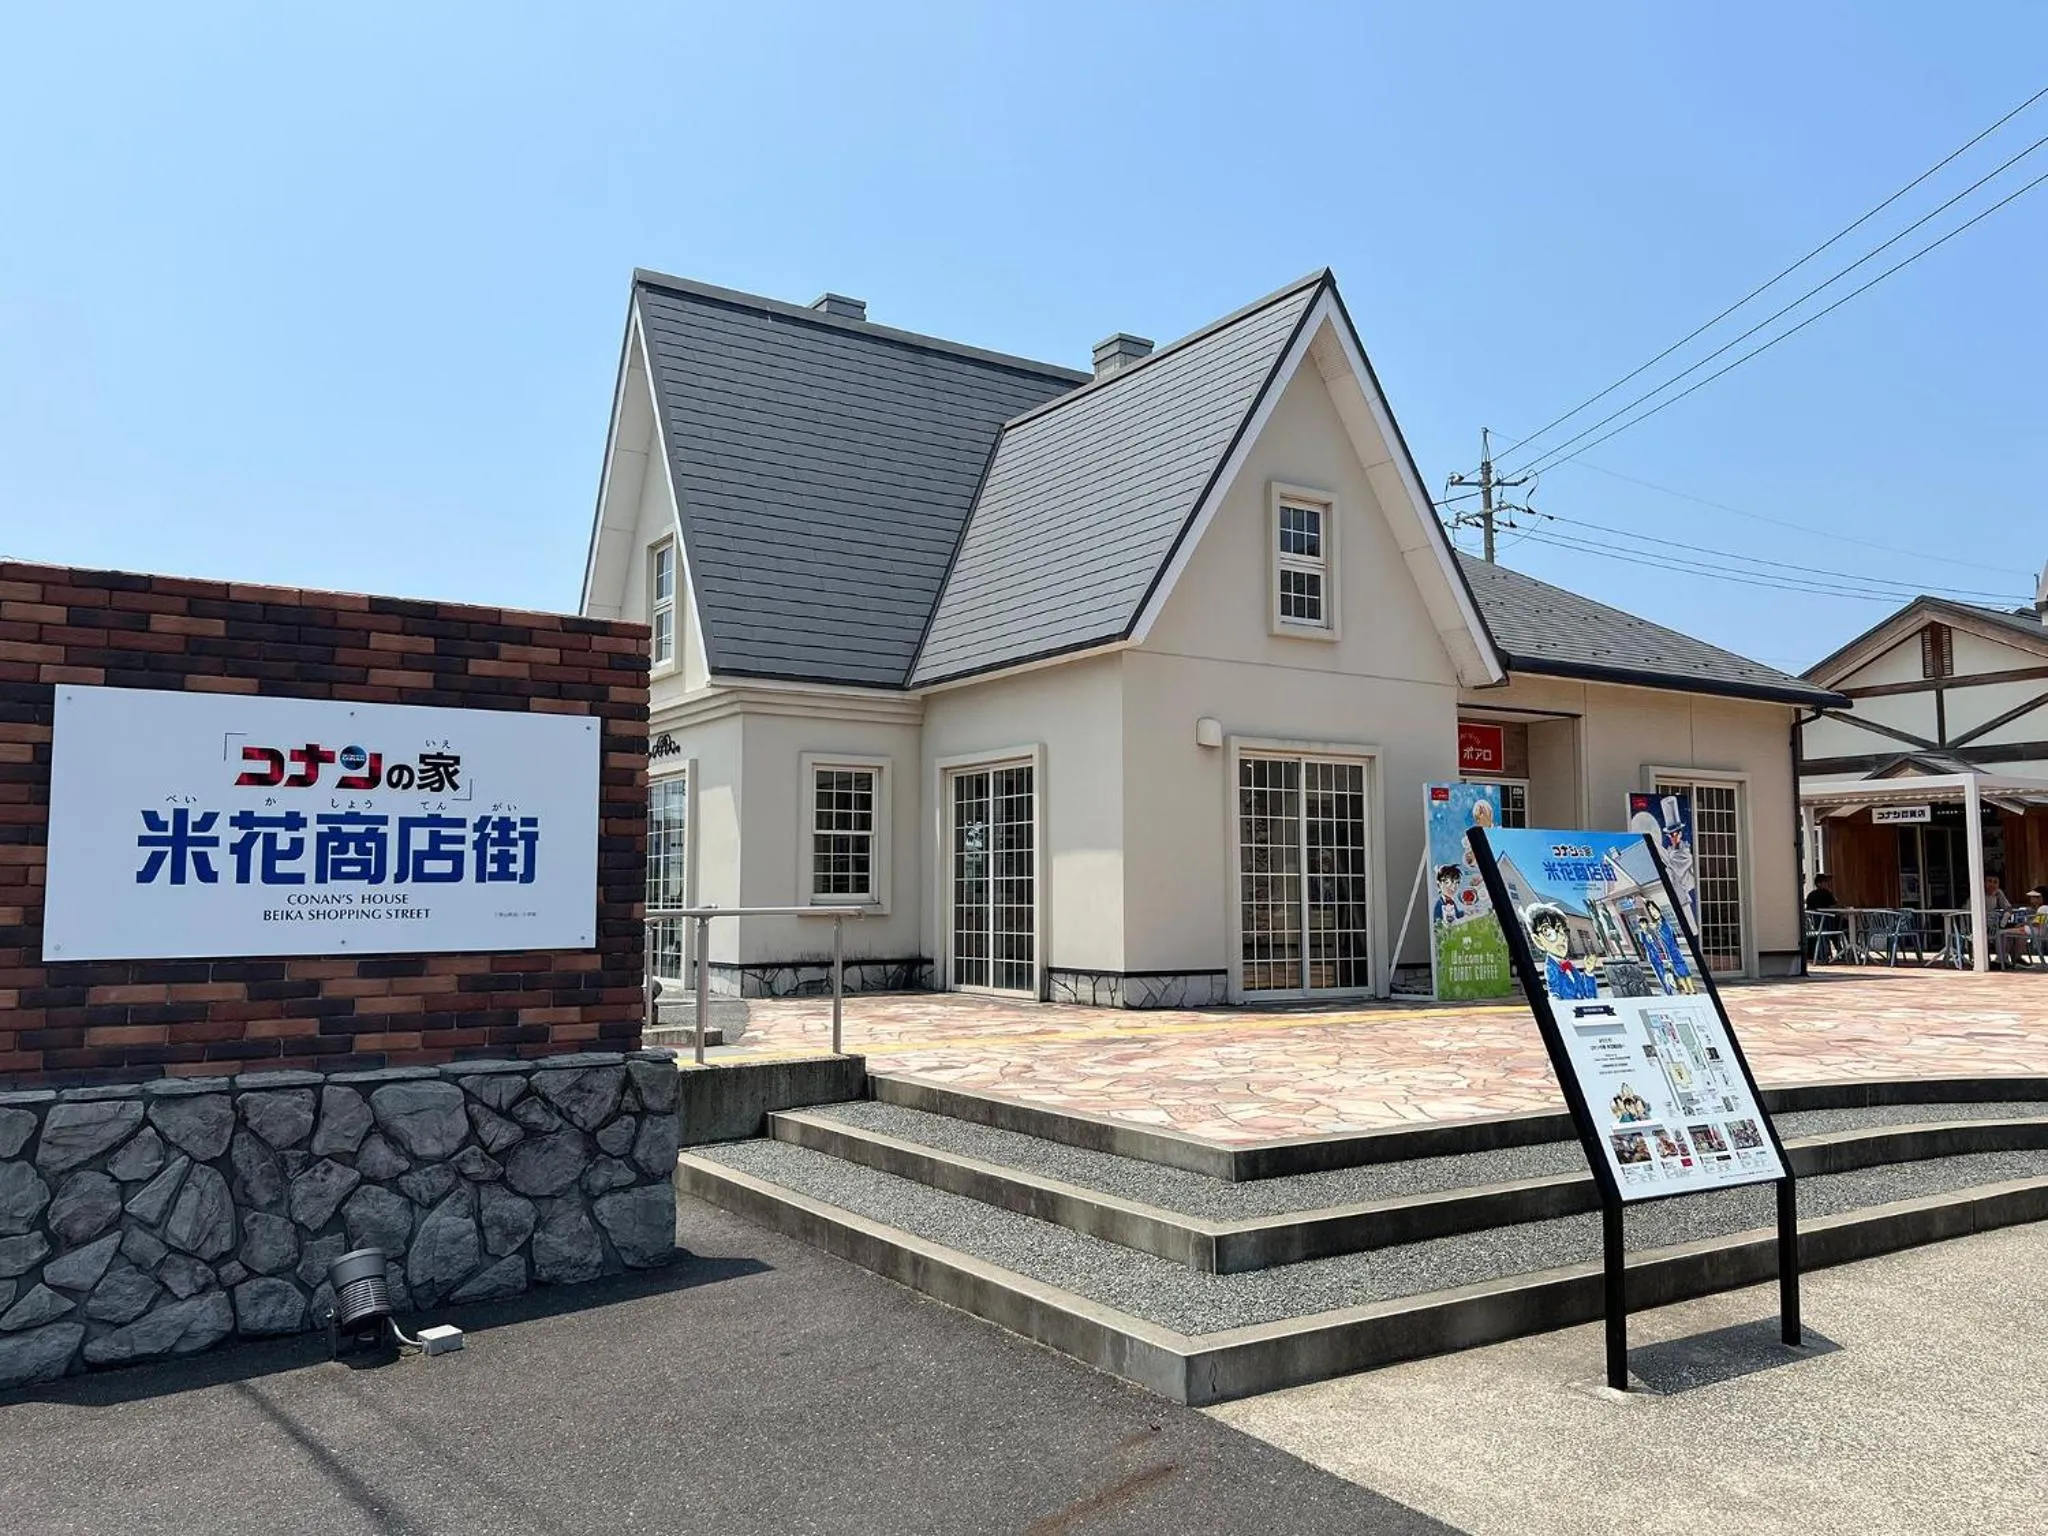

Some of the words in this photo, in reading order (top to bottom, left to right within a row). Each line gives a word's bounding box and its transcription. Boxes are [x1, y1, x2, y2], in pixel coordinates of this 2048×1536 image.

[1463, 746, 1492, 761] ポアロ
[264, 796, 277, 807] か
[135, 807, 540, 885] 米花商店街
[287, 893, 353, 906] CONAN'S
[361, 893, 409, 905] HOUSE
[263, 909, 303, 921] BEIKA
[308, 908, 382, 921] SHOPPING
[386, 908, 431, 920] STREET
